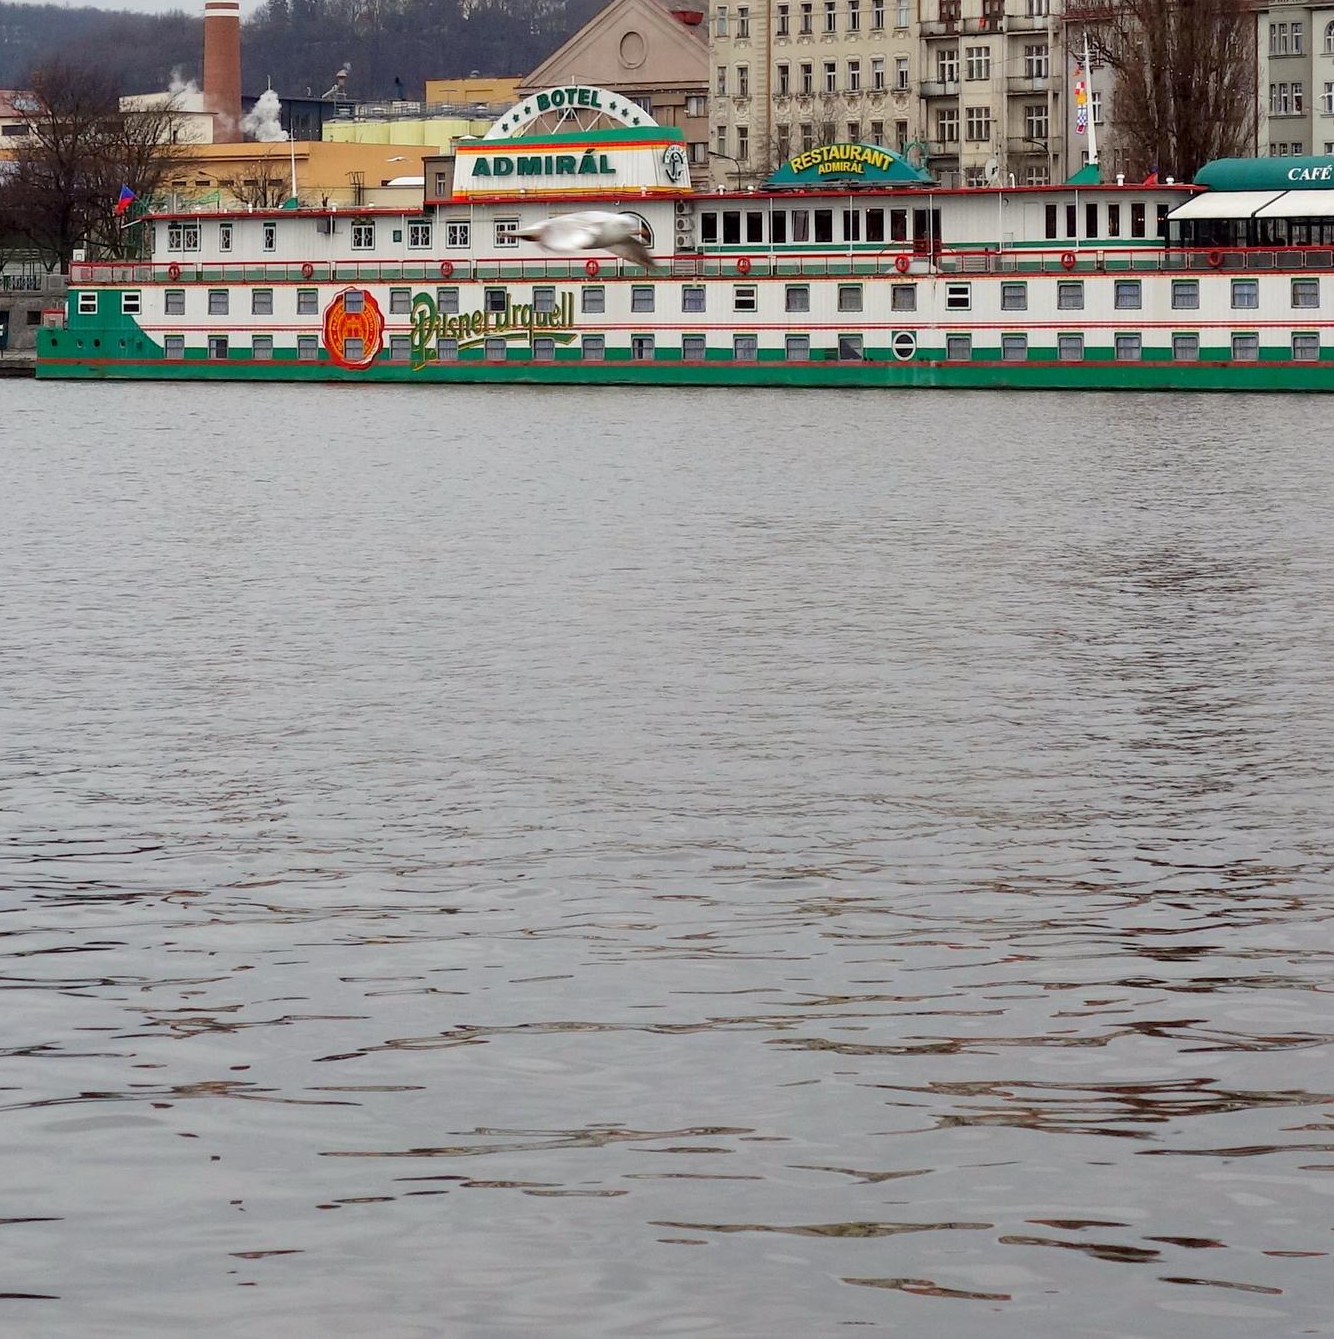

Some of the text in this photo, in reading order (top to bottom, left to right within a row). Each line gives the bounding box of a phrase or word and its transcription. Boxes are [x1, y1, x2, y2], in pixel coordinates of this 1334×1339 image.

[536, 88, 602, 112] BOTEL
[471, 148, 617, 176] ADMIRÁL
[790, 144, 894, 174] RESTAURANT
[1288, 165, 1334, 181] CAFÉ
